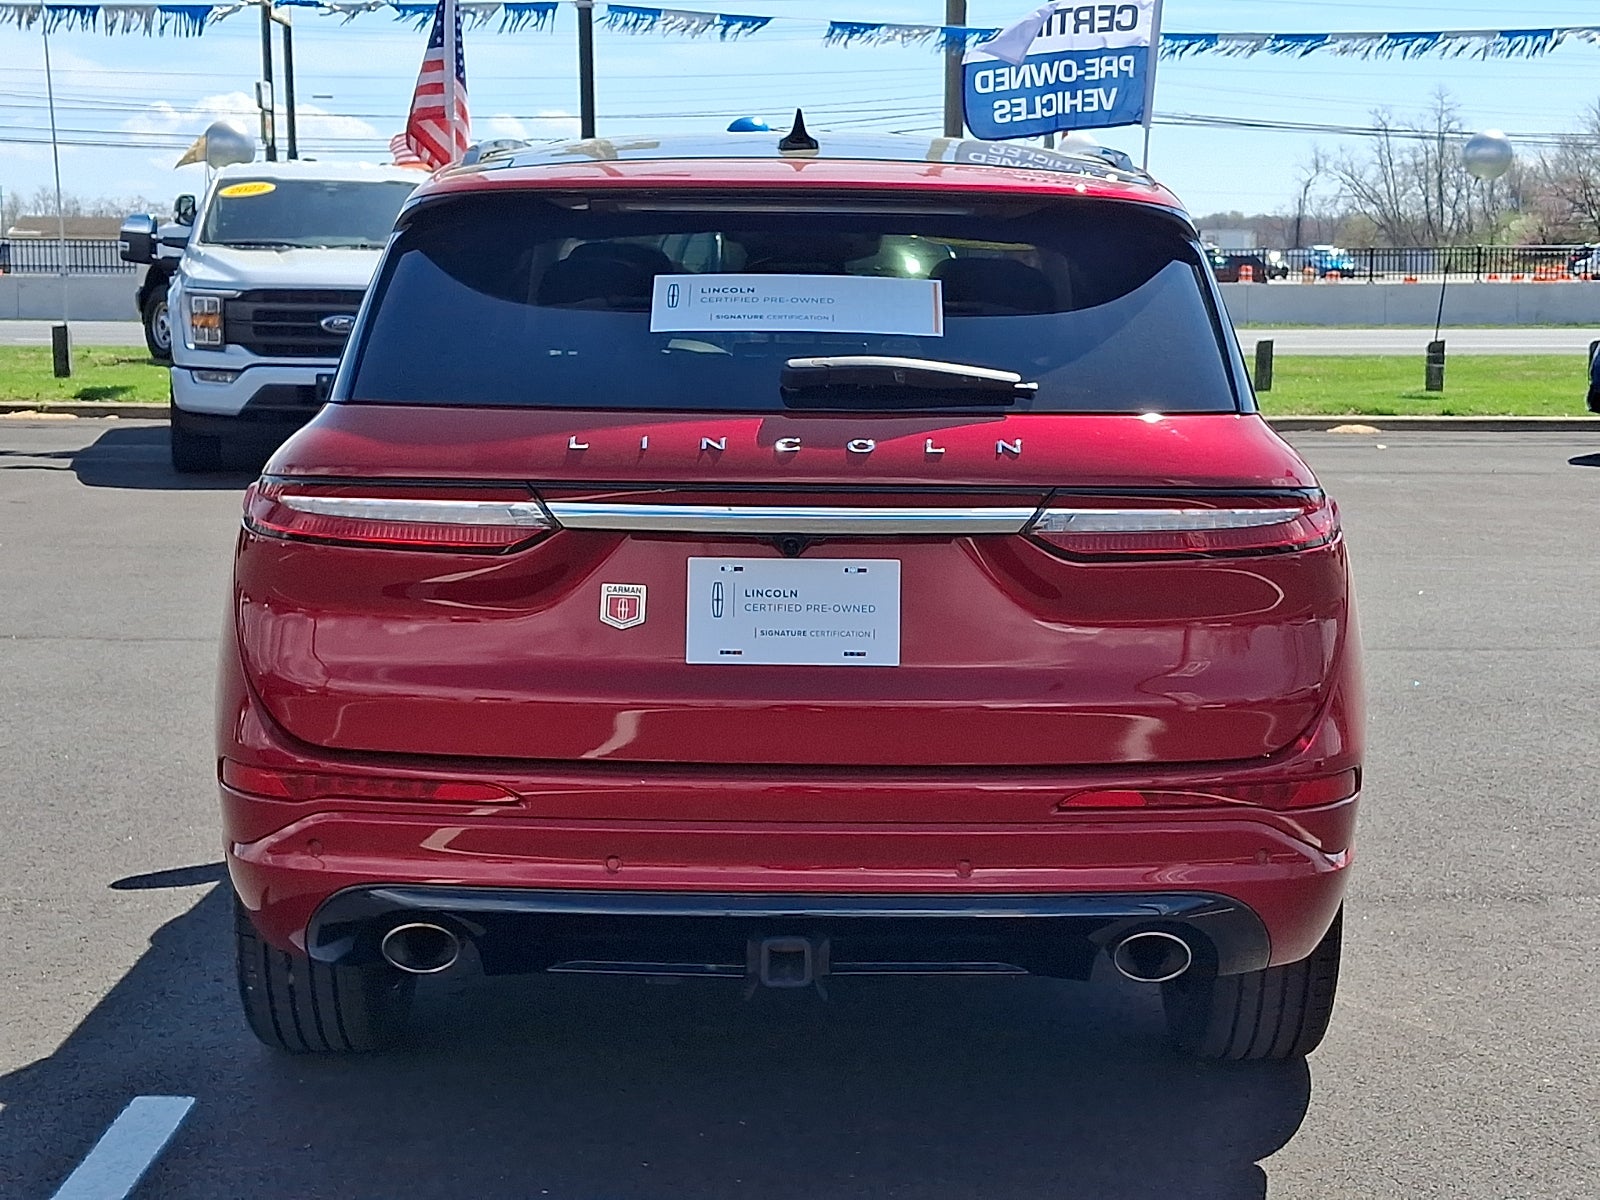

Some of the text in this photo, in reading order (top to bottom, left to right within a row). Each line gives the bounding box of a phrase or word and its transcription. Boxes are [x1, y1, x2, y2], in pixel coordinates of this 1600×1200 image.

[700, 296, 836, 305] CERTIFIED PRE-OWNED
[568, 435, 1022, 455] LINCOLN
[606, 585, 642, 594] CARMAN
[744, 588, 799, 598] LINCOLN
[744, 603, 877, 614] CERTIFIED PRE-OWNED
[760, 629, 871, 639] SIGNATURE CERTIFICATION
